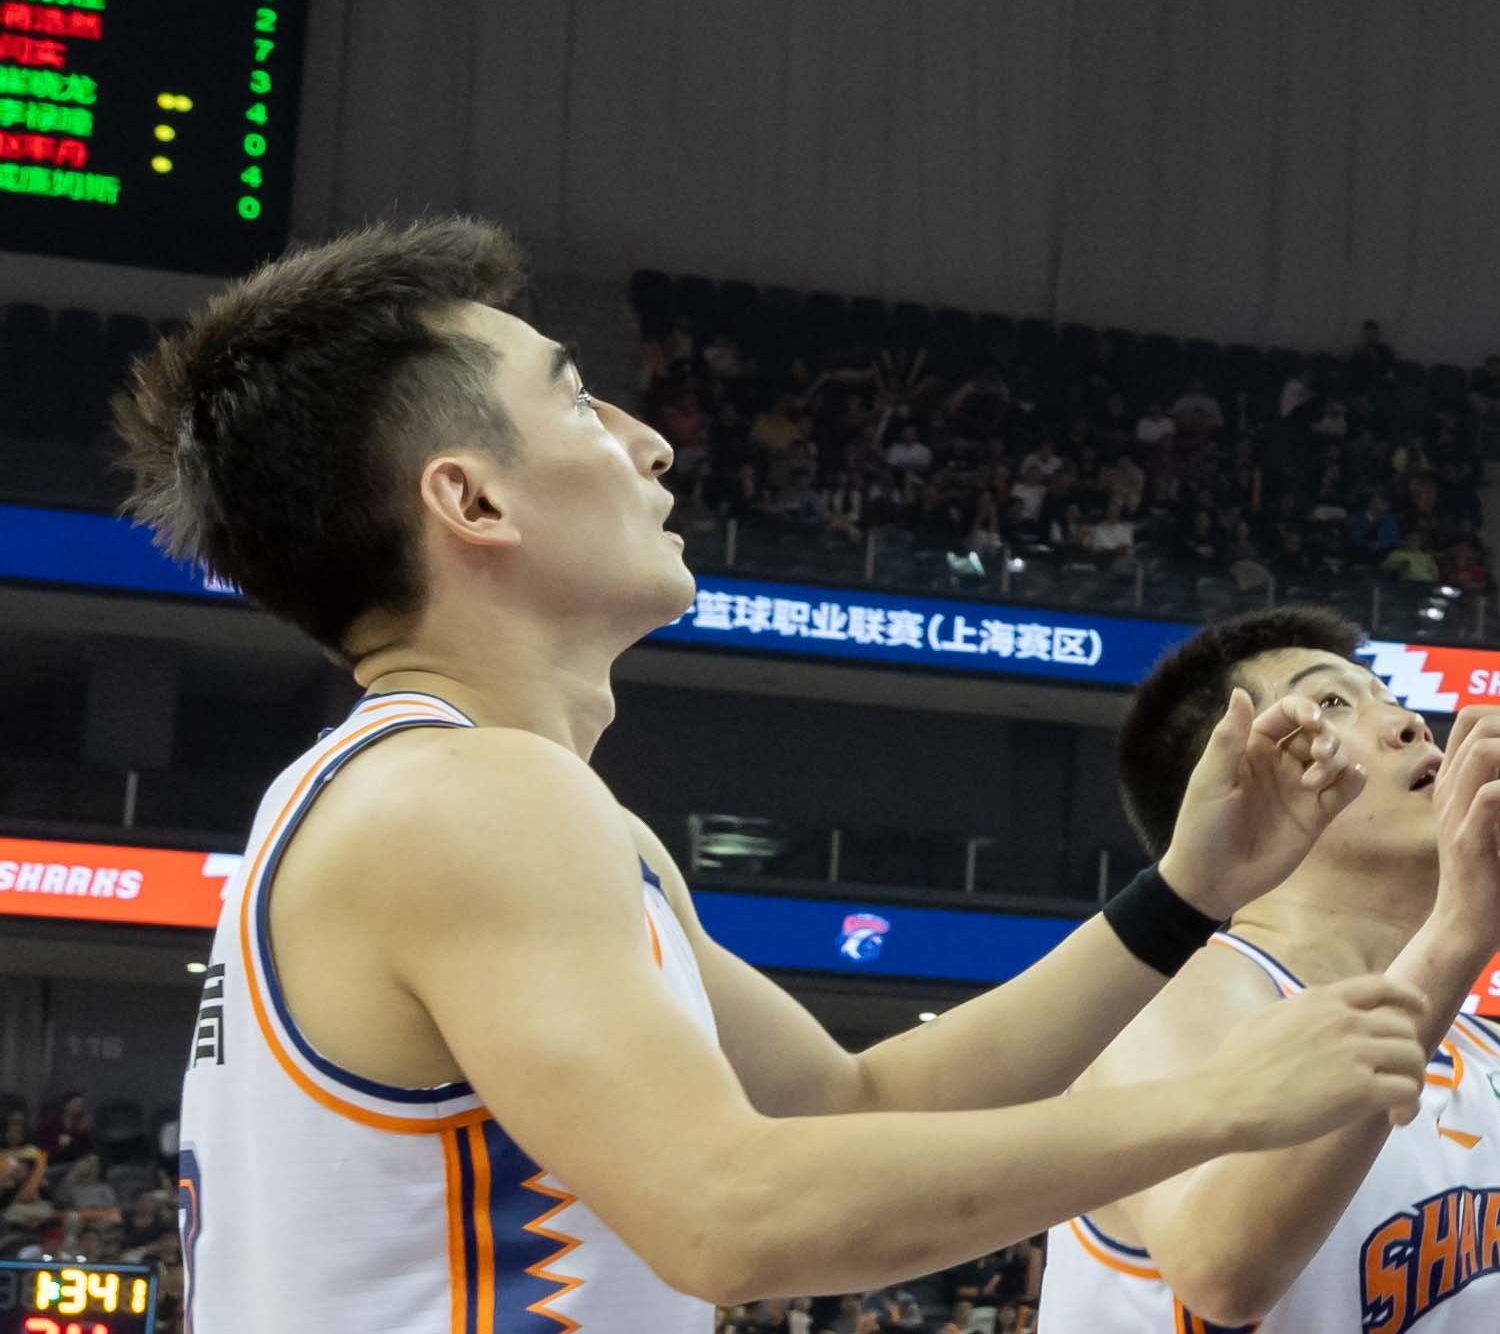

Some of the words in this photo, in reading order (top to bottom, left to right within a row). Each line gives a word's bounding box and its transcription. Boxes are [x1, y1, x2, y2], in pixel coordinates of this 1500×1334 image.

[255, 7, 278, 32] 2
[253, 38, 275, 62] 7
[243, 133, 267, 157] 0
[237, 195, 261, 219] 0
